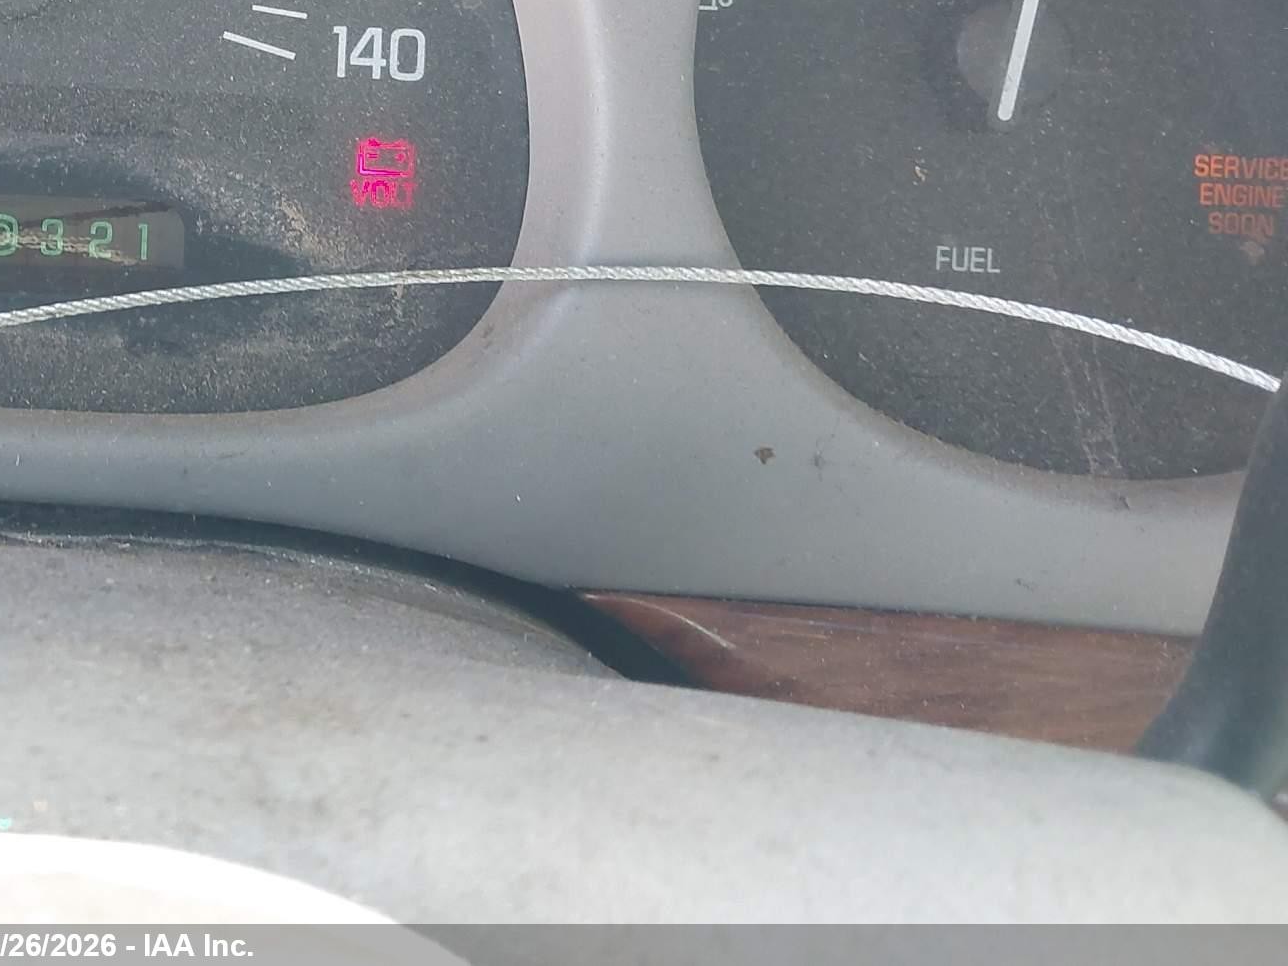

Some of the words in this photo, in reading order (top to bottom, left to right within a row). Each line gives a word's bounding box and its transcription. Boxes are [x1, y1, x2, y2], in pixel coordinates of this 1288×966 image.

[333, 26, 426, 81] 140
[1194, 154, 1288, 181] SERVICE
[350, 179, 416, 208] VOLT
[1199, 182, 1285, 208] ENGINE
[1208, 212, 1273, 237] SOON
[40, 218, 65, 256] 3
[89, 221, 113, 260] 2
[138, 223, 149, 261] 1
[935, 245, 1001, 274] FUEL
